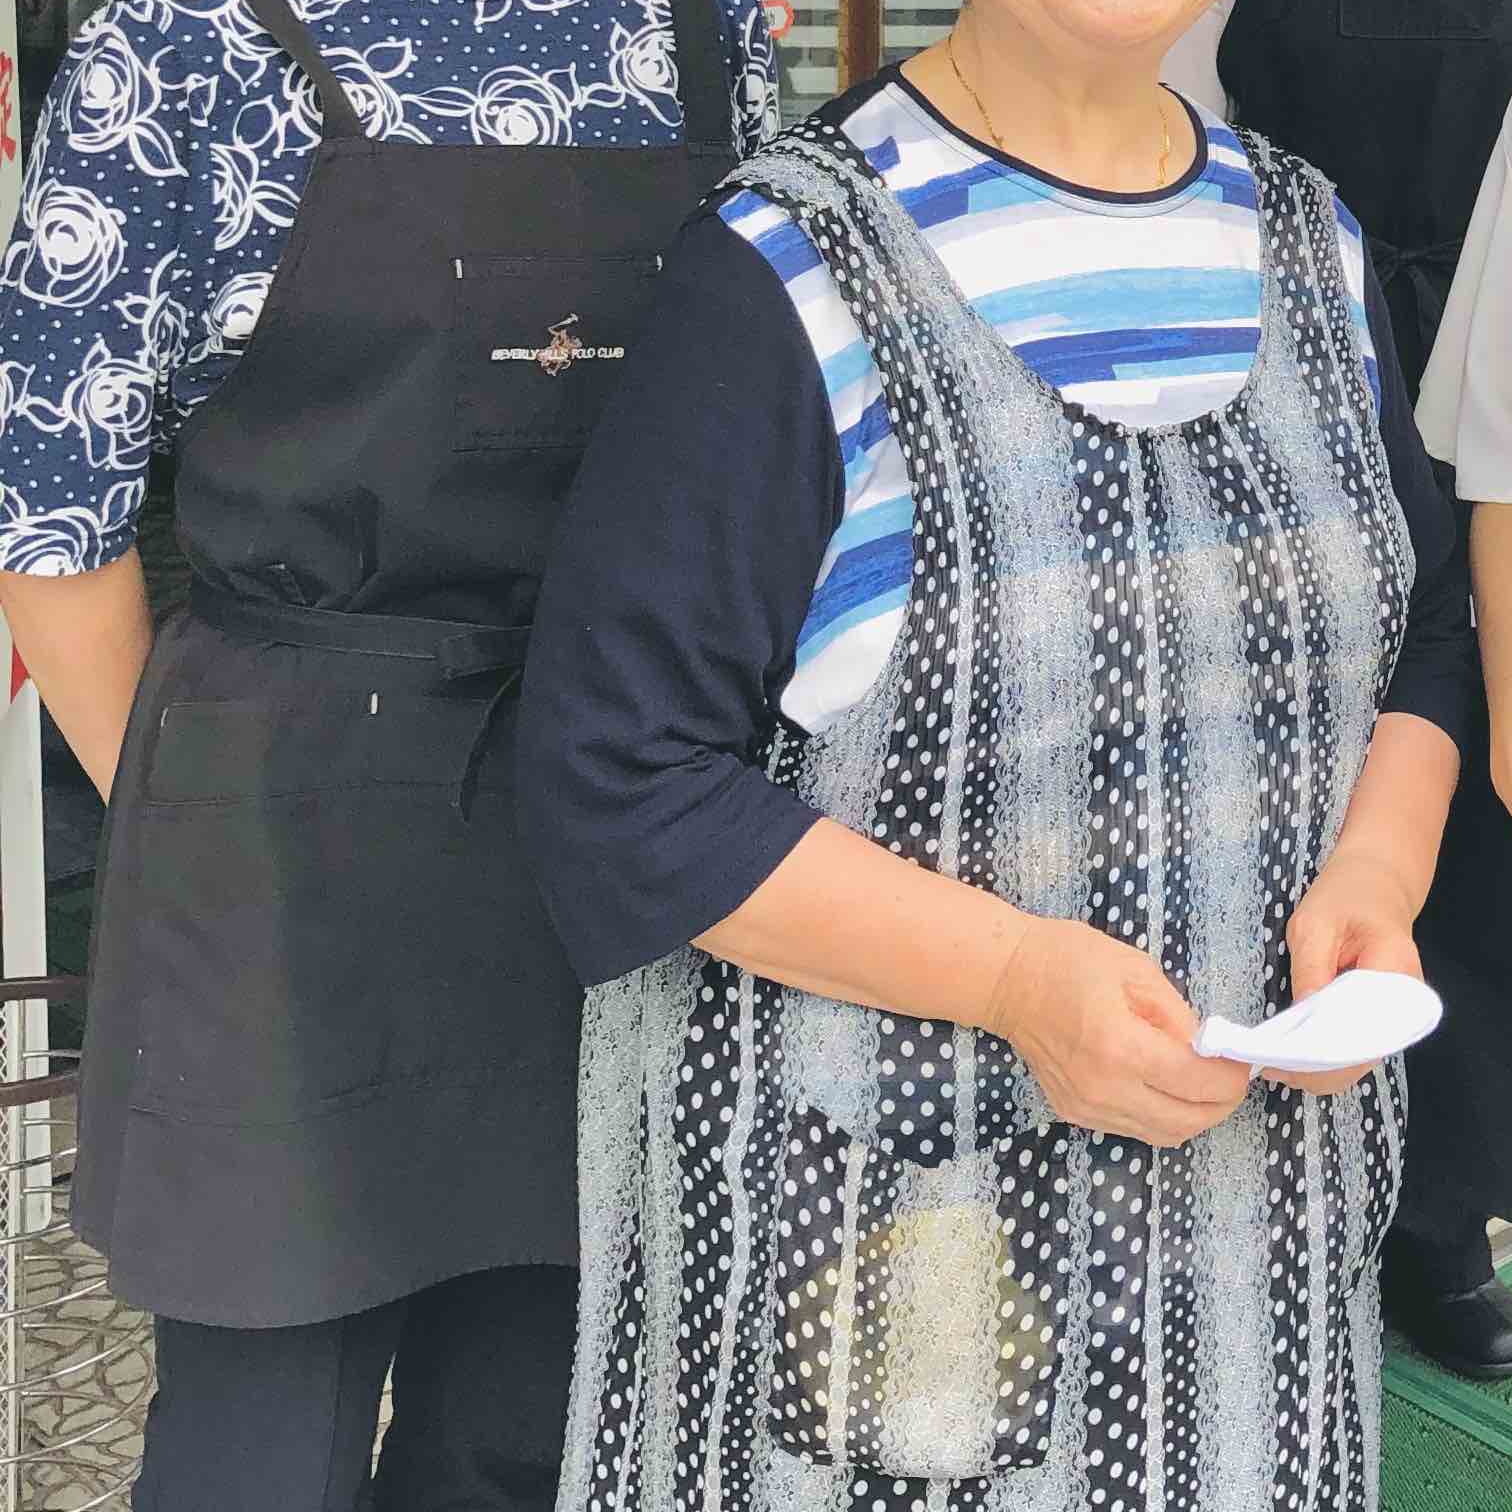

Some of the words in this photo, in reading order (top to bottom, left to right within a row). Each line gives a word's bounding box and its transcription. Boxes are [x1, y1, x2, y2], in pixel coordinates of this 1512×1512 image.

[491, 348, 537, 361] BEVERLY
[571, 348, 595, 360] POLO
[597, 347, 625, 359] CLUB
